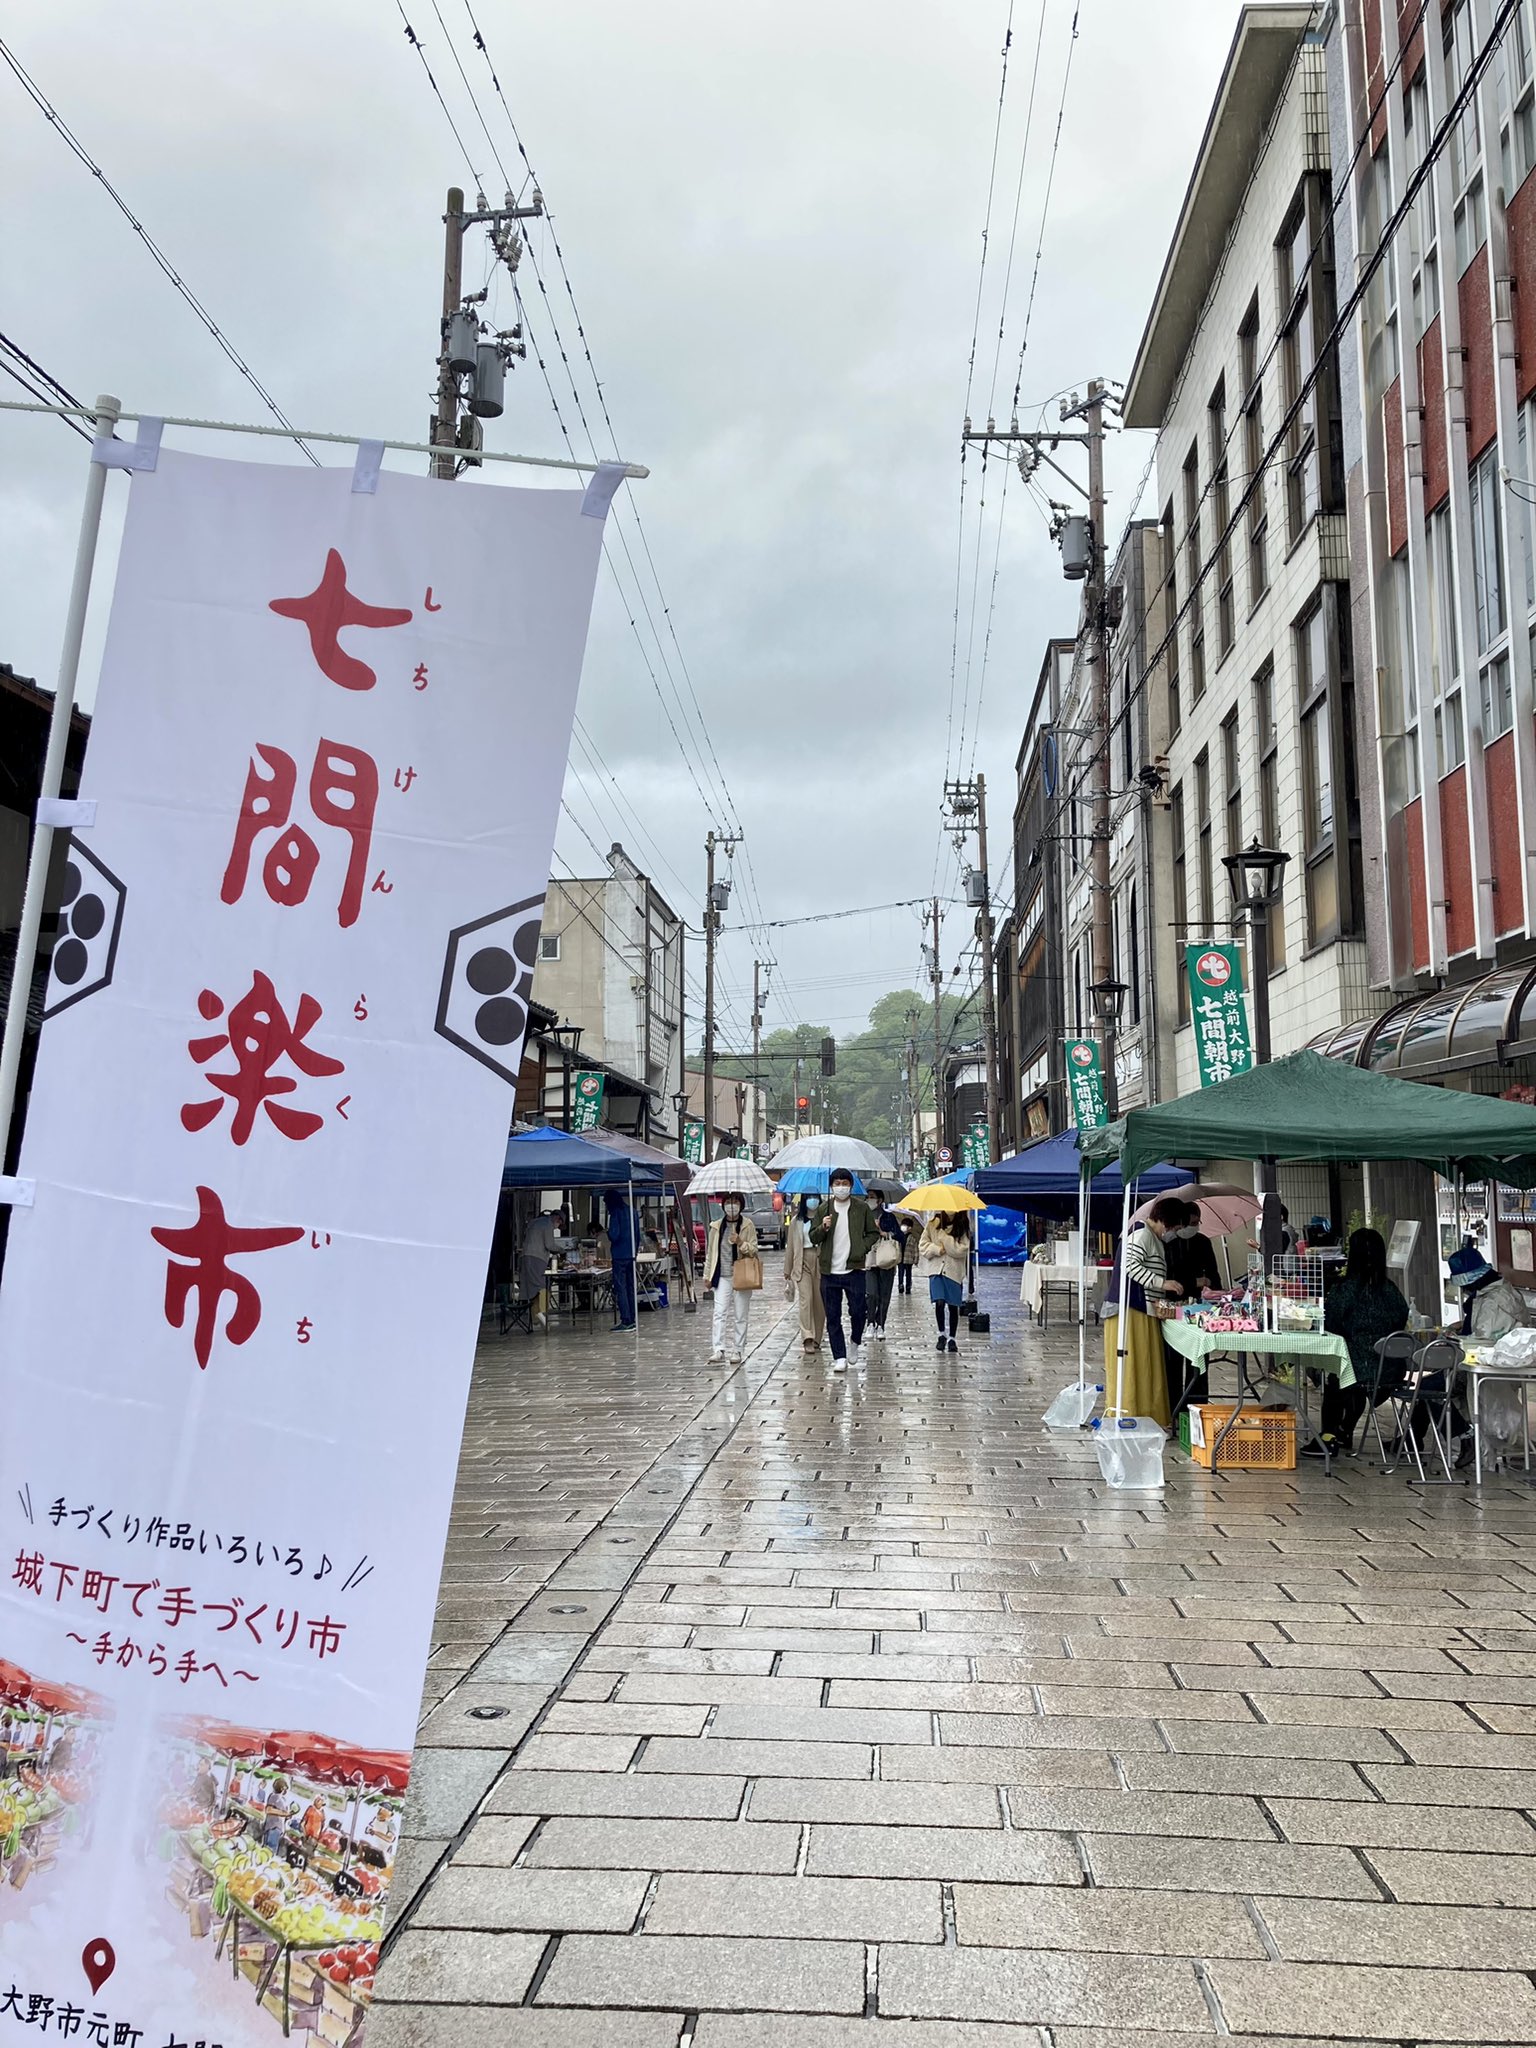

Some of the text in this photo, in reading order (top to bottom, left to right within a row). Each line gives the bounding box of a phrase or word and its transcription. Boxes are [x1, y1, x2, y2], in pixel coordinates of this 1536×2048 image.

[150, 547, 414, 1370] 七間楽市
[1196, 996, 1233, 1083] 七間朝市
[1223, 989, 1246, 1066] 越前大野
[1072, 1072, 1097, 1126] 七間朝市
[11, 1548, 347, 1659] 城下町で手づくり市
